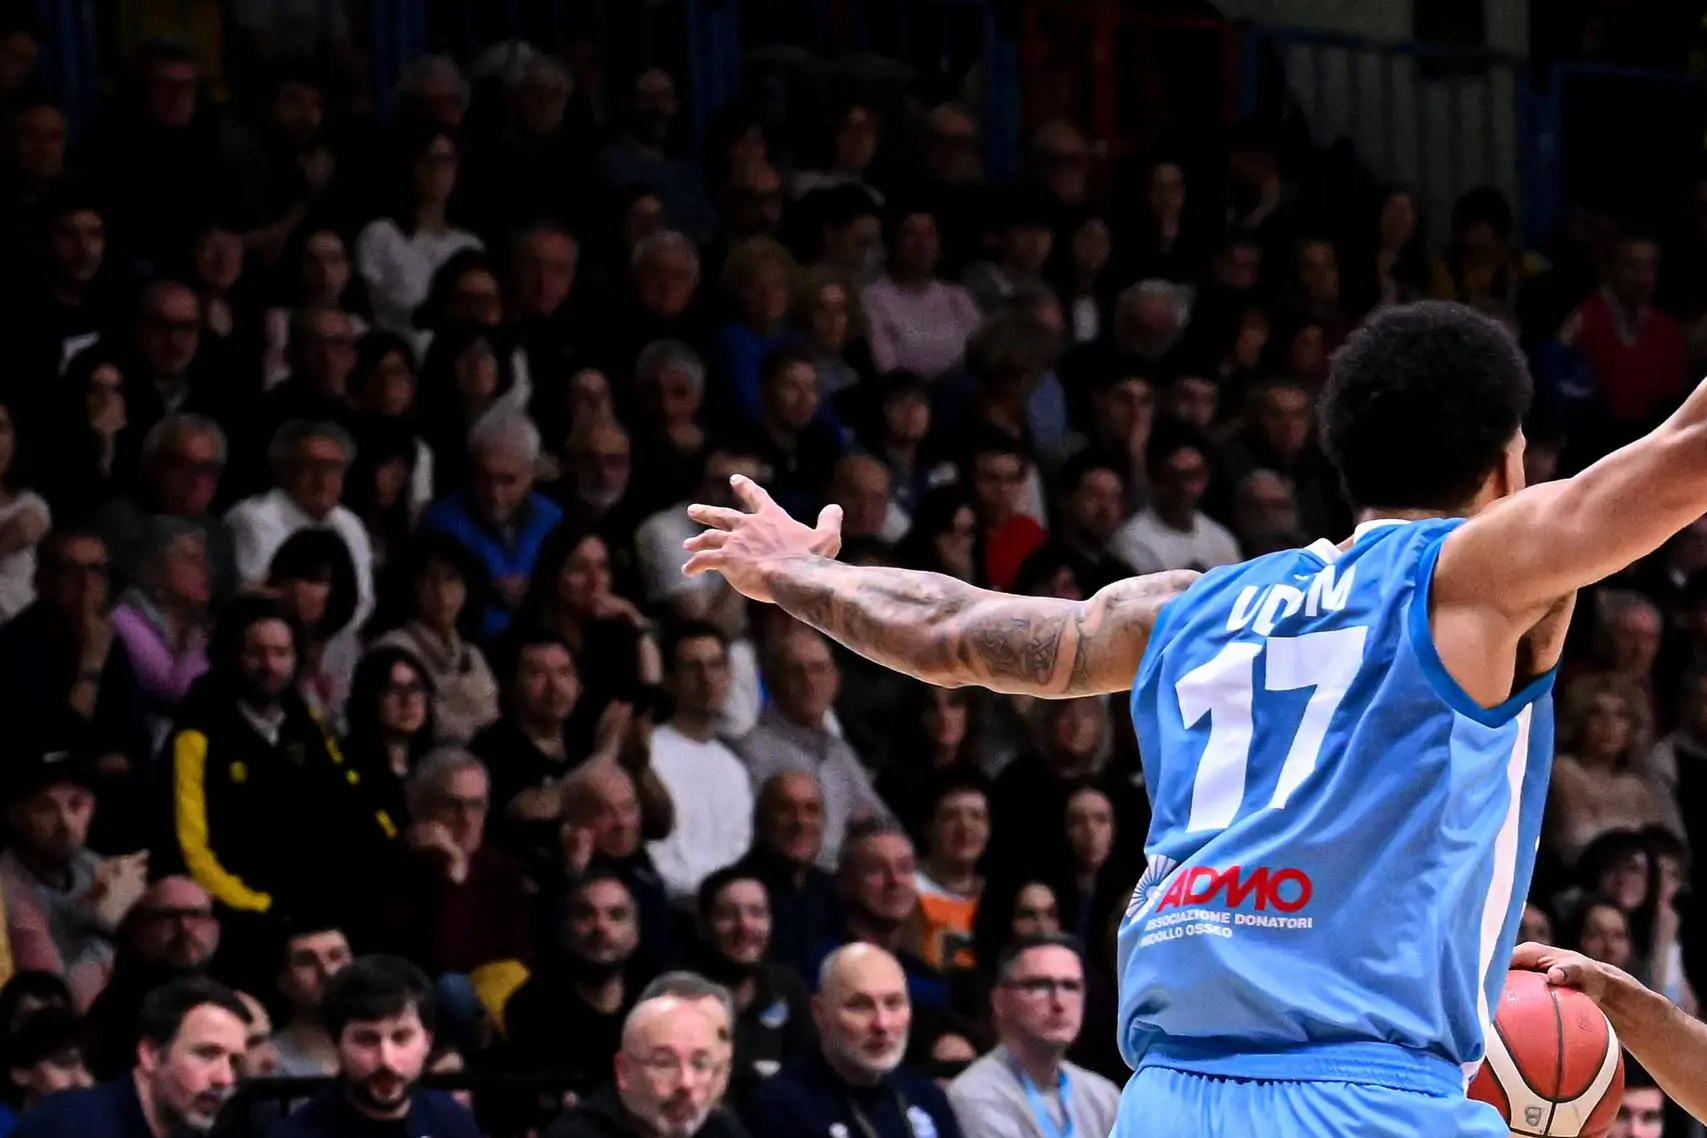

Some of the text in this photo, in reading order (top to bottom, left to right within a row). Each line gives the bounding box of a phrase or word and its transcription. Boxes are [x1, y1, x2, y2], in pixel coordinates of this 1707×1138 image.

[1225, 564, 1357, 637] UDM
[1175, 625, 1369, 833] 17
[1156, 864, 1313, 914] ADMO
[1185, 923, 1233, 938] OSSEO
[1234, 912, 1313, 929] DONATORI
